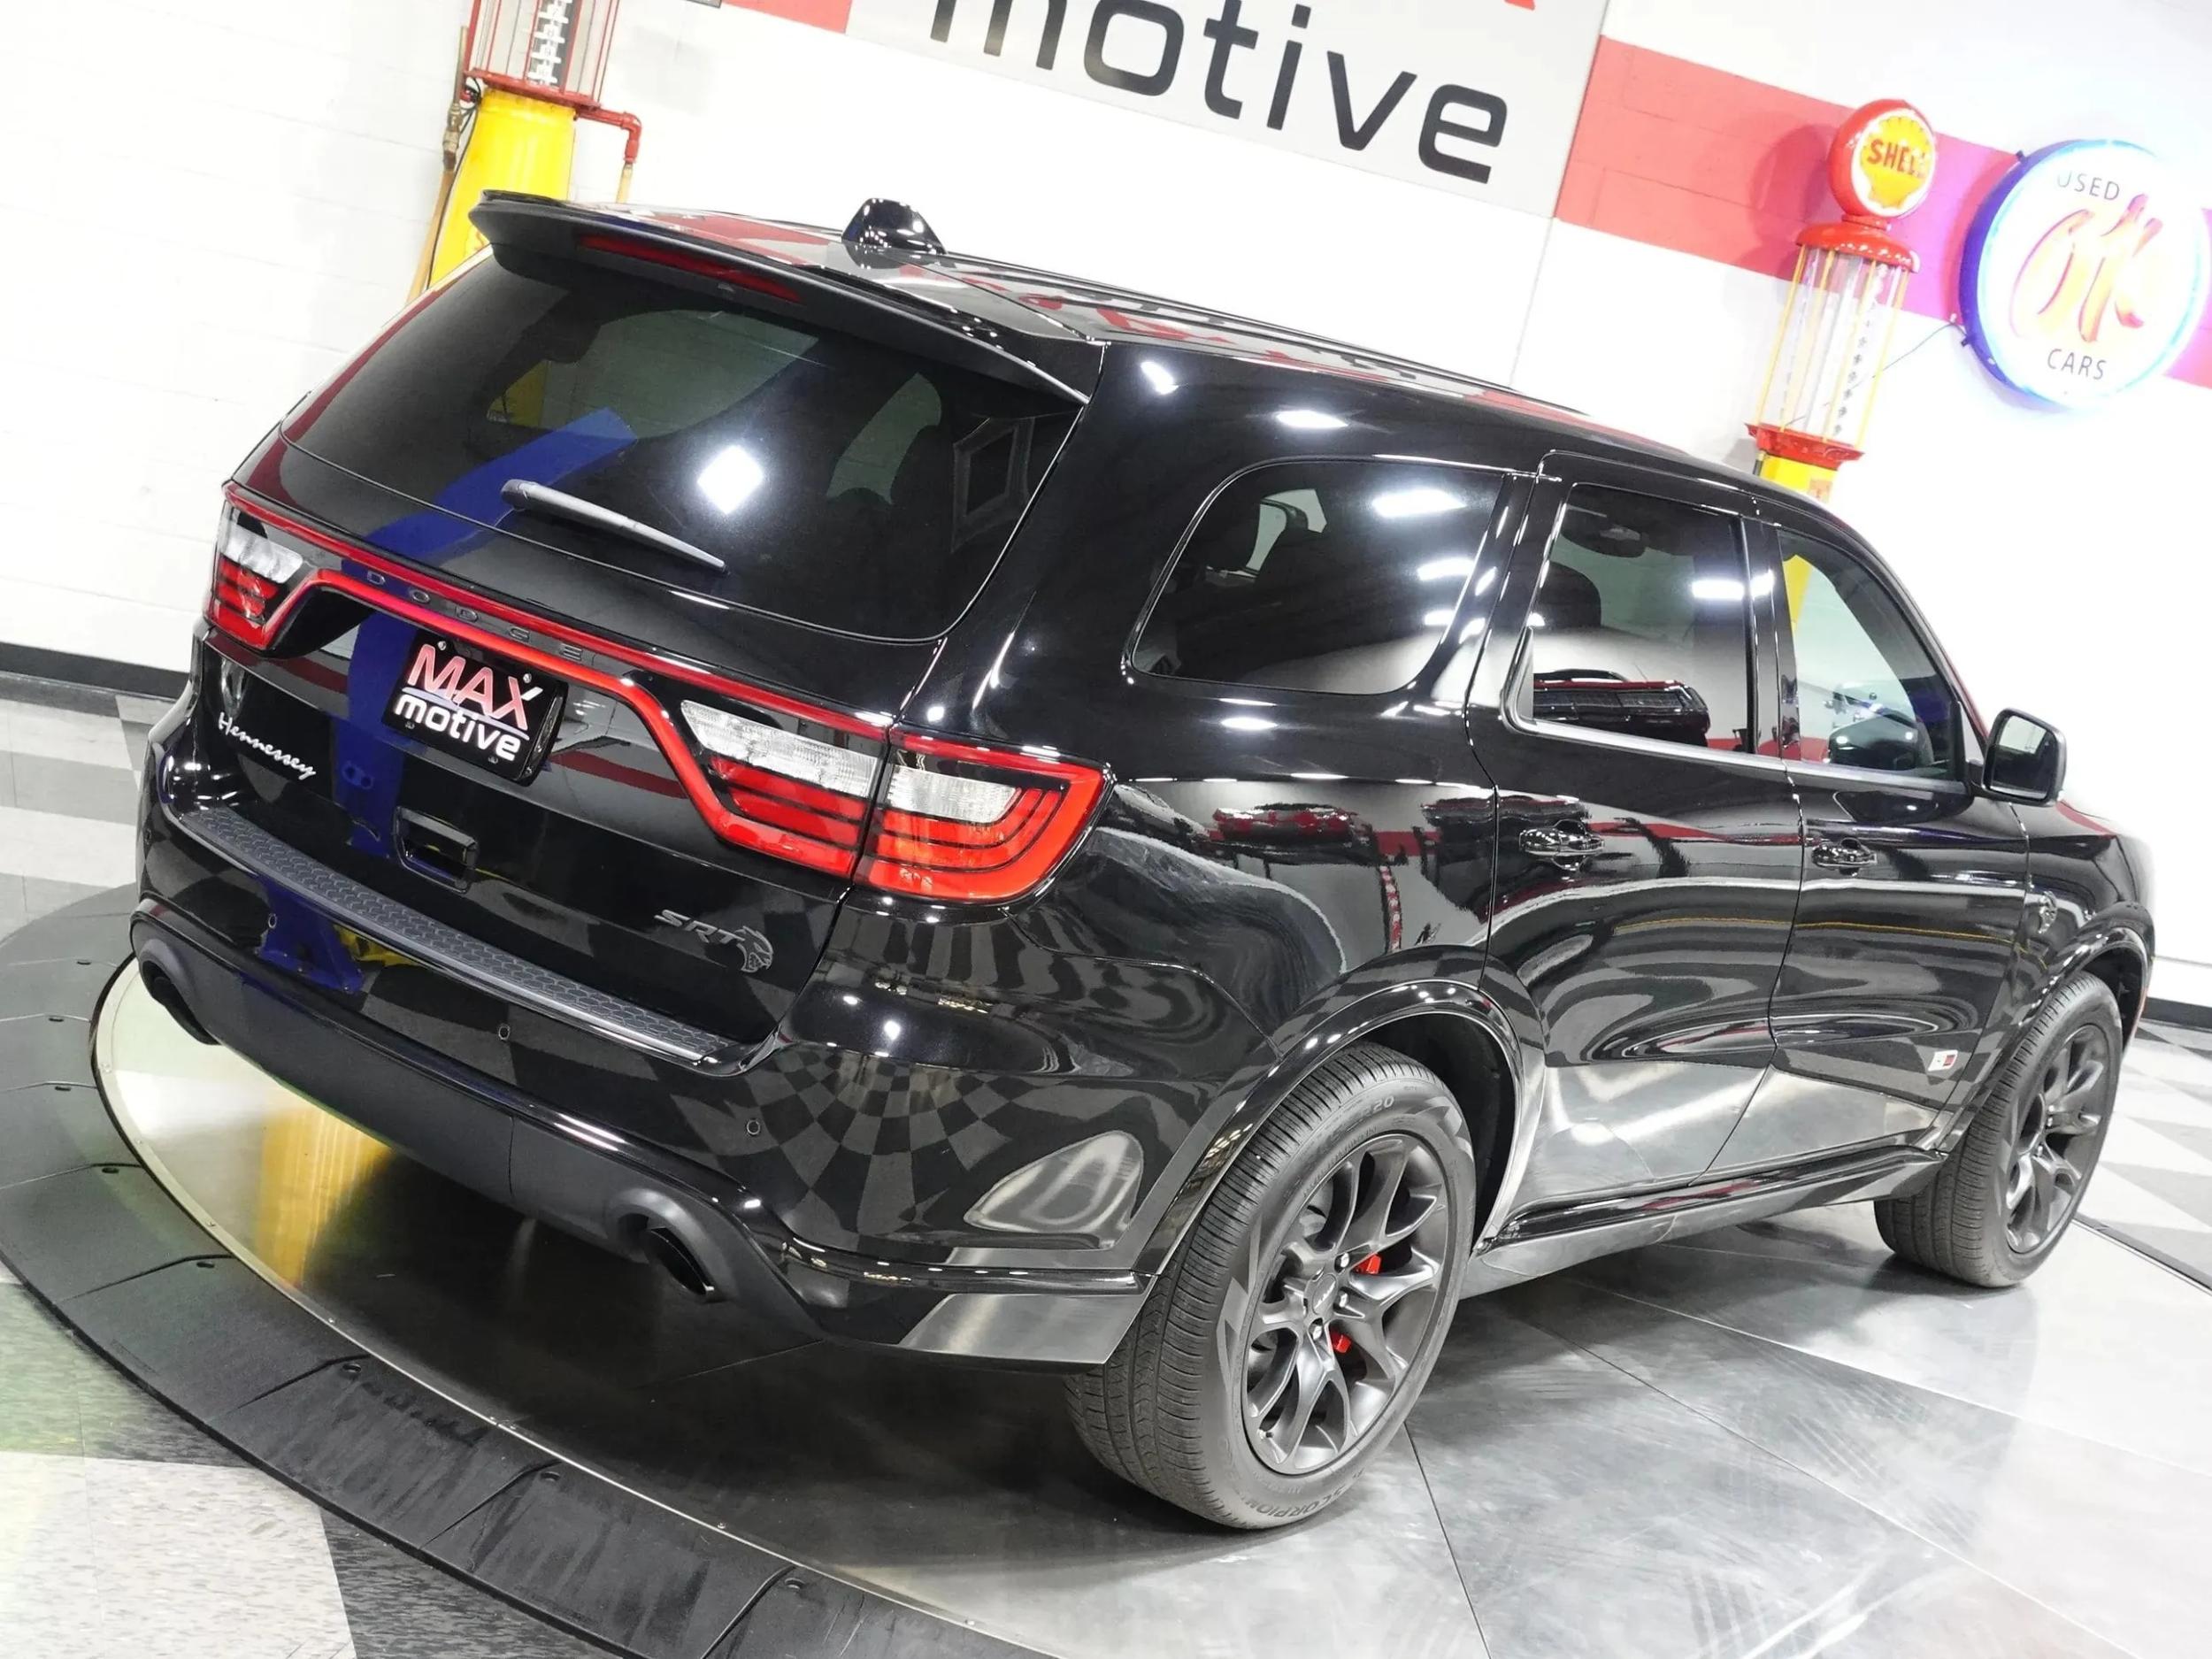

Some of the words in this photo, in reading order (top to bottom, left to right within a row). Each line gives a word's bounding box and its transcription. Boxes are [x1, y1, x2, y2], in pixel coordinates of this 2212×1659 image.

[2057, 172, 2120, 201] USED
[2047, 349, 2107, 380] CARS
[367, 570, 582, 662] DODGE
[407, 643, 543, 731] MAX
[218, 711, 317, 780] Hennessey
[395, 694, 520, 762] motive
[654, 909, 746, 944] SRT
